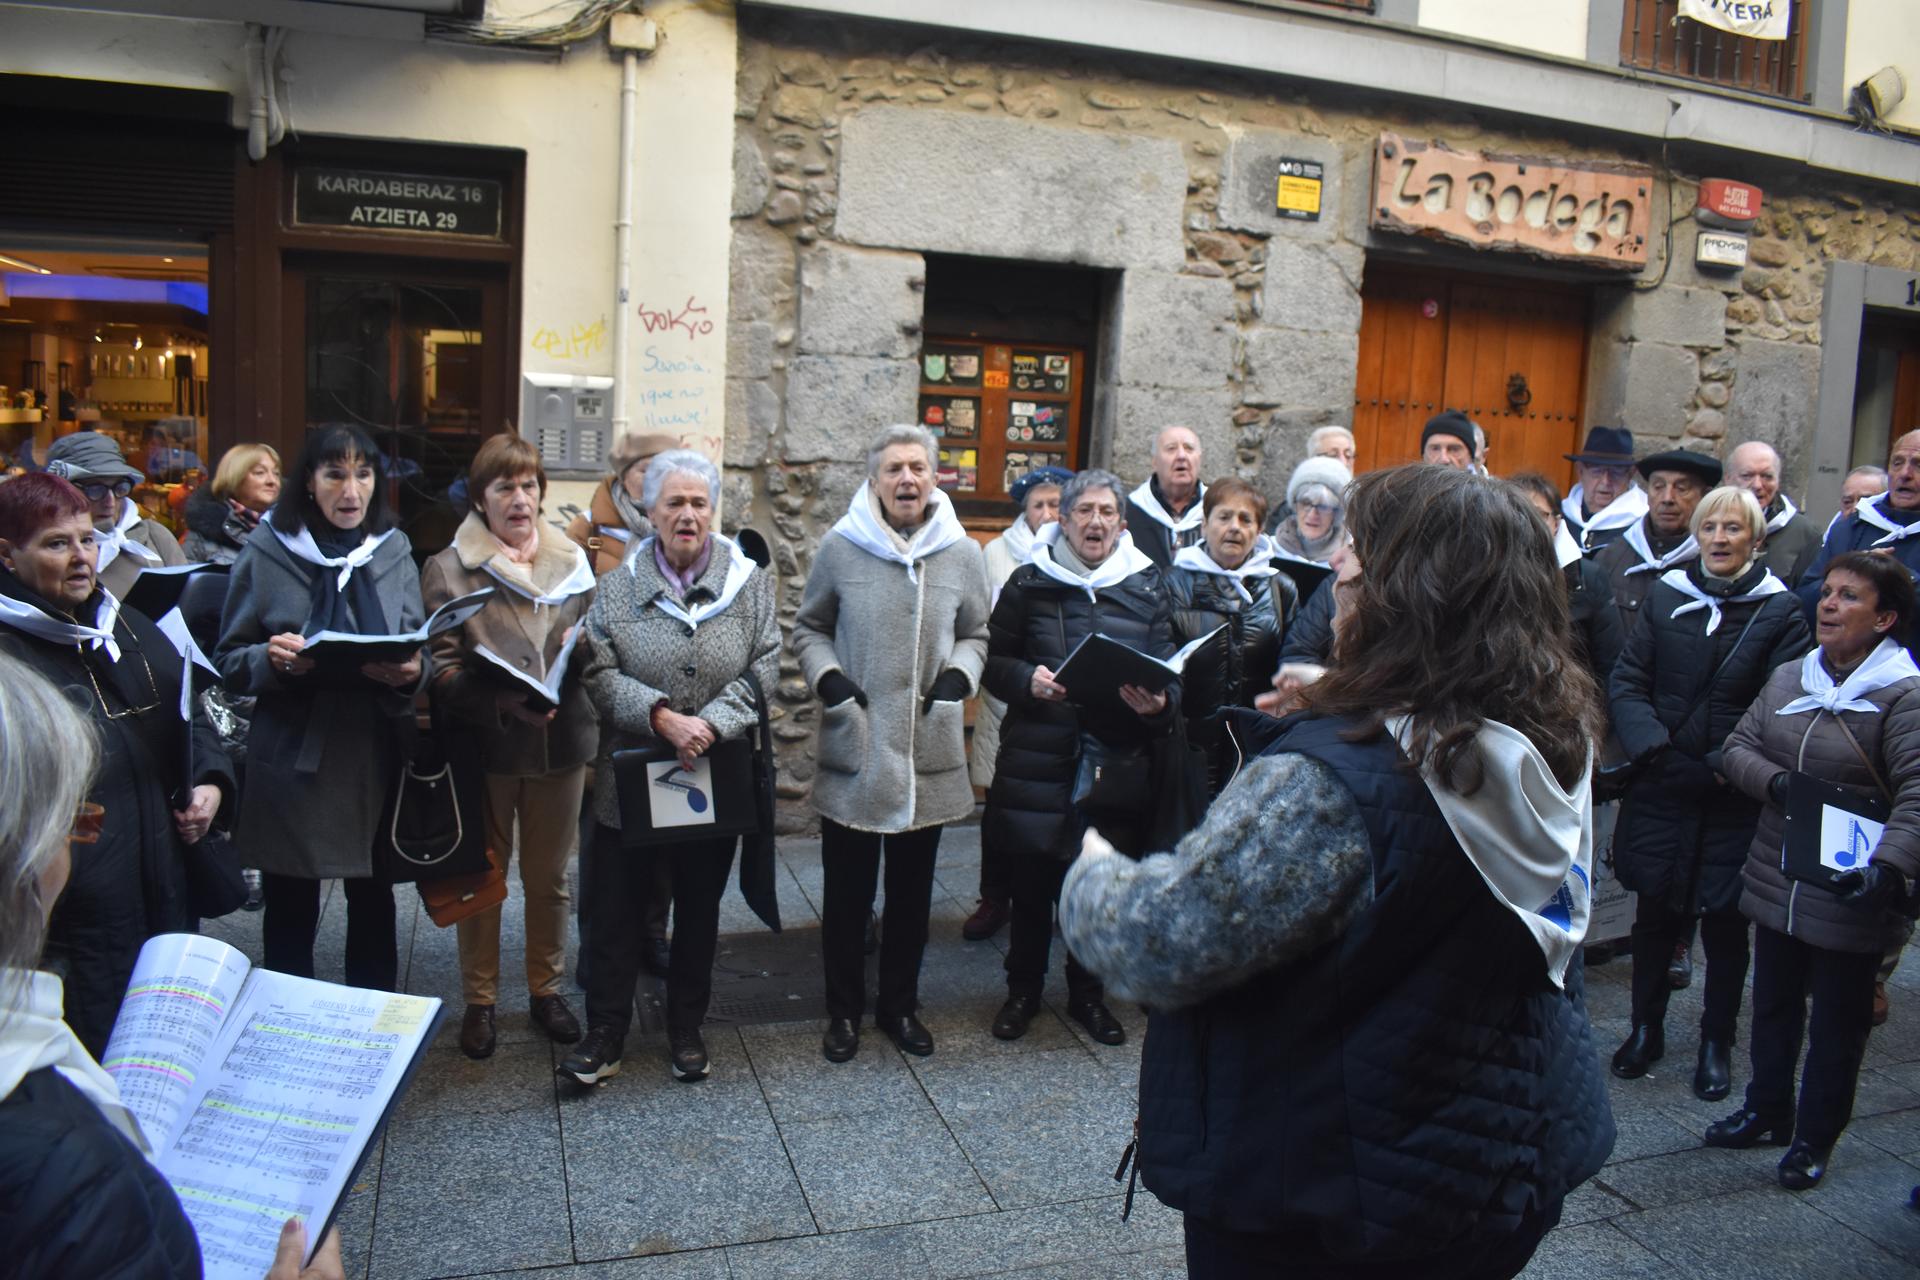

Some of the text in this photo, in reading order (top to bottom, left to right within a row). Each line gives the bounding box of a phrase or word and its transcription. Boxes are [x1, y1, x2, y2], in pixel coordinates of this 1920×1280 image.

[317, 175, 483, 203] KARDABERAZ 16
[351, 206, 457, 229] ATZIETA 29
[1392, 158, 1634, 254] La Bodega
